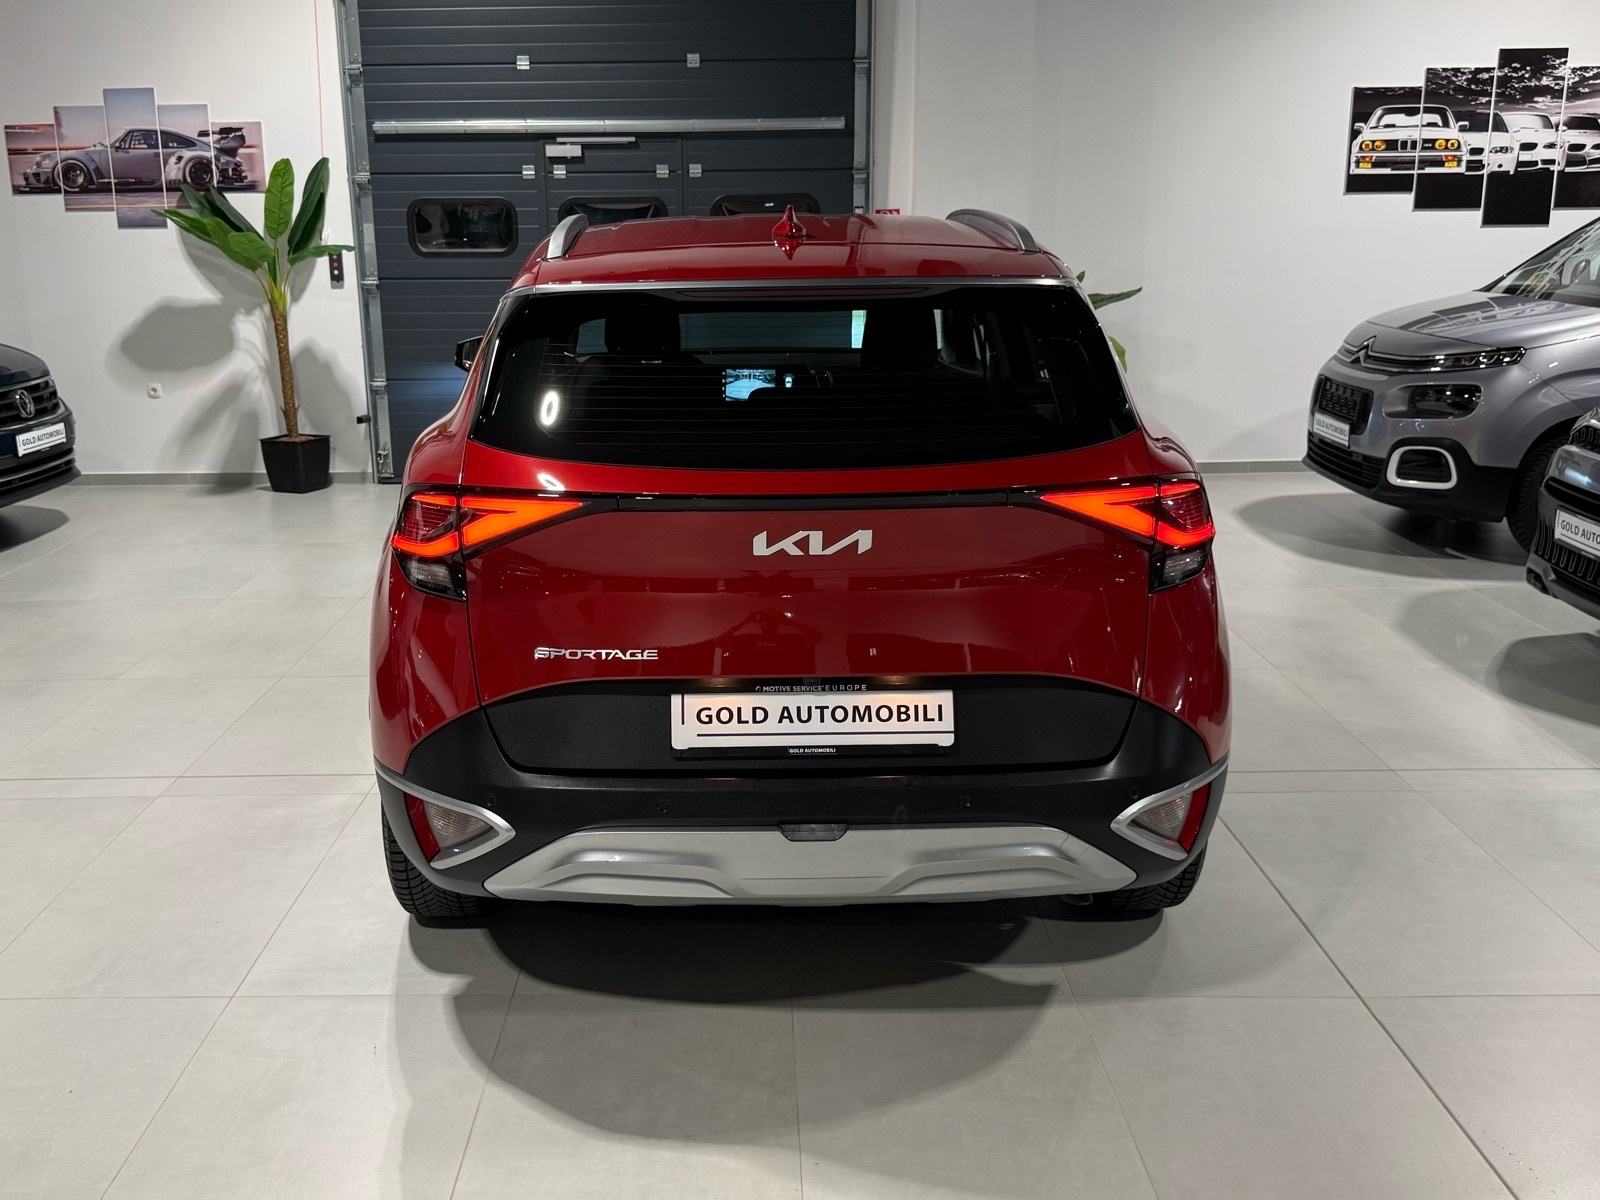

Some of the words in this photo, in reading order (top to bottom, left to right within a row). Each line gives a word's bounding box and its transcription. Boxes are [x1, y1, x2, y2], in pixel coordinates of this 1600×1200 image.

[22, 435, 37, 447] GOLD
[1560, 519, 1580, 536] GOLD
[752, 529, 873, 556] KIA
[534, 647, 659, 661] SPORTAGE
[762, 685, 791, 693] MOTIVE
[695, 706, 769, 725] GOLD
[777, 703, 943, 725] AUTOMOBILI
